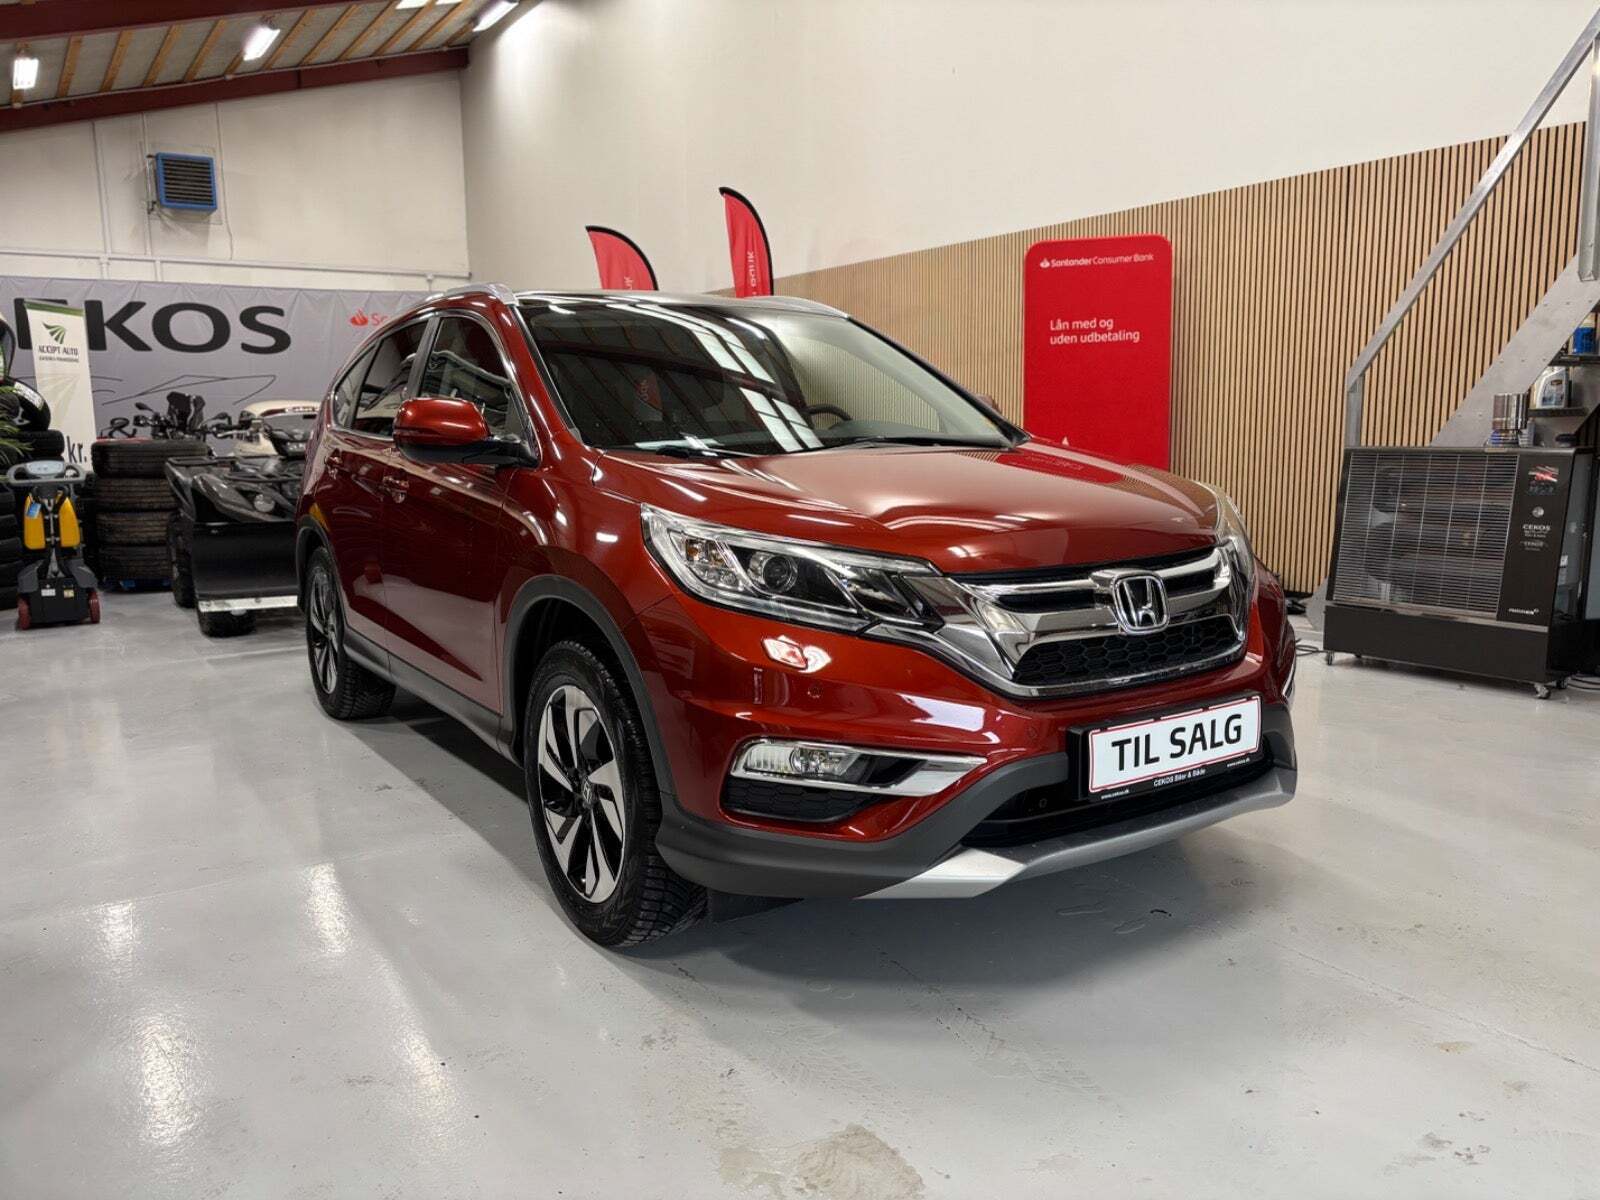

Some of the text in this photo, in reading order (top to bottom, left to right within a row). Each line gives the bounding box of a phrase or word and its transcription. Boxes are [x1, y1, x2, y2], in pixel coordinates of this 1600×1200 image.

[1051, 253, 1154, 268] Santander Consumer Bank
[1050, 317, 1114, 331] Lån med og
[1050, 330, 1140, 345] uden udbetaling
[66, 435, 87, 463] kr.
[1111, 713, 1242, 771] TIL SALG
